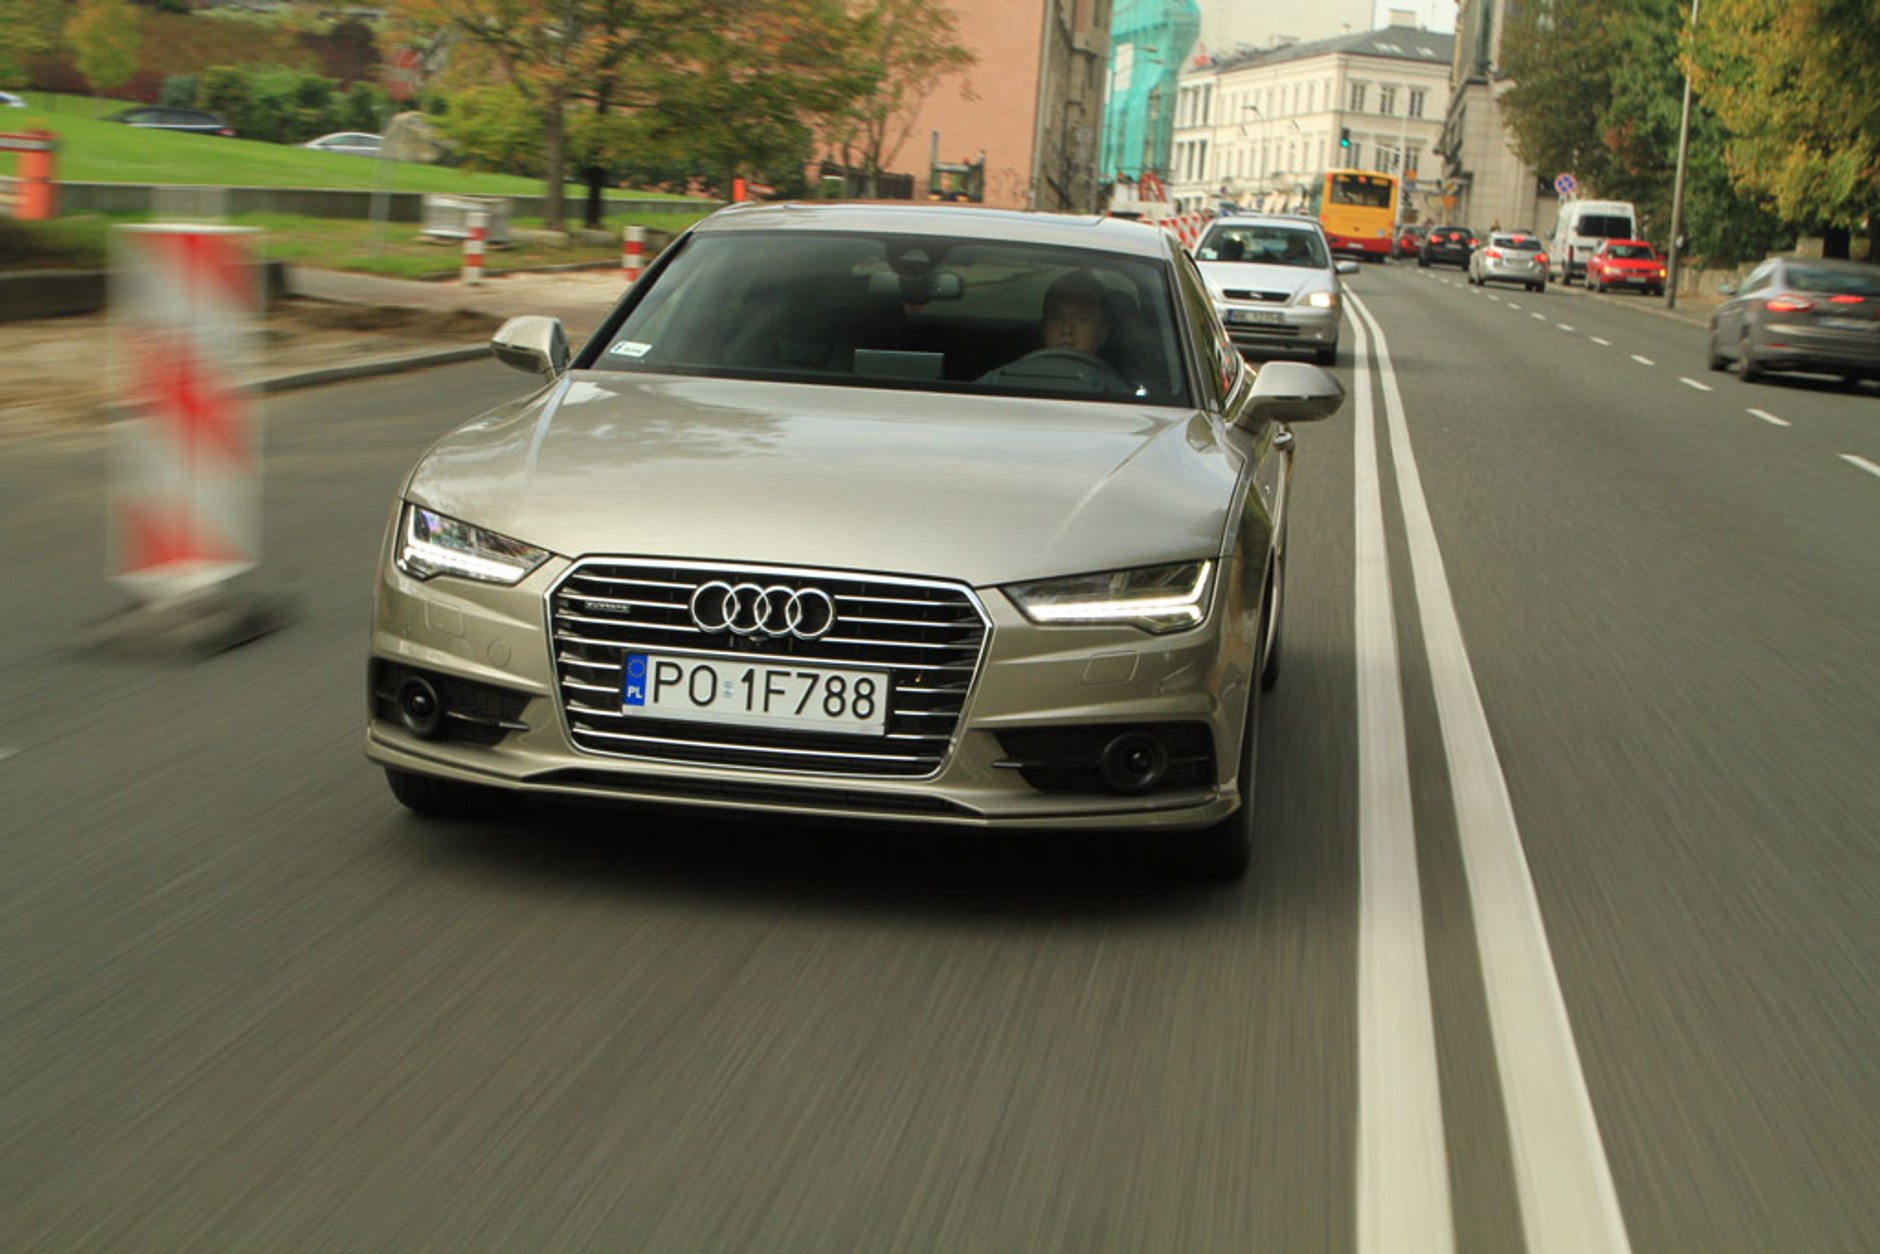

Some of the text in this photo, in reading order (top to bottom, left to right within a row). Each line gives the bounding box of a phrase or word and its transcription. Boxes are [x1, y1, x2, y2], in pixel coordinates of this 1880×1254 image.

[627, 685, 643, 699] PL
[653, 661, 875, 719] PO 1F788
